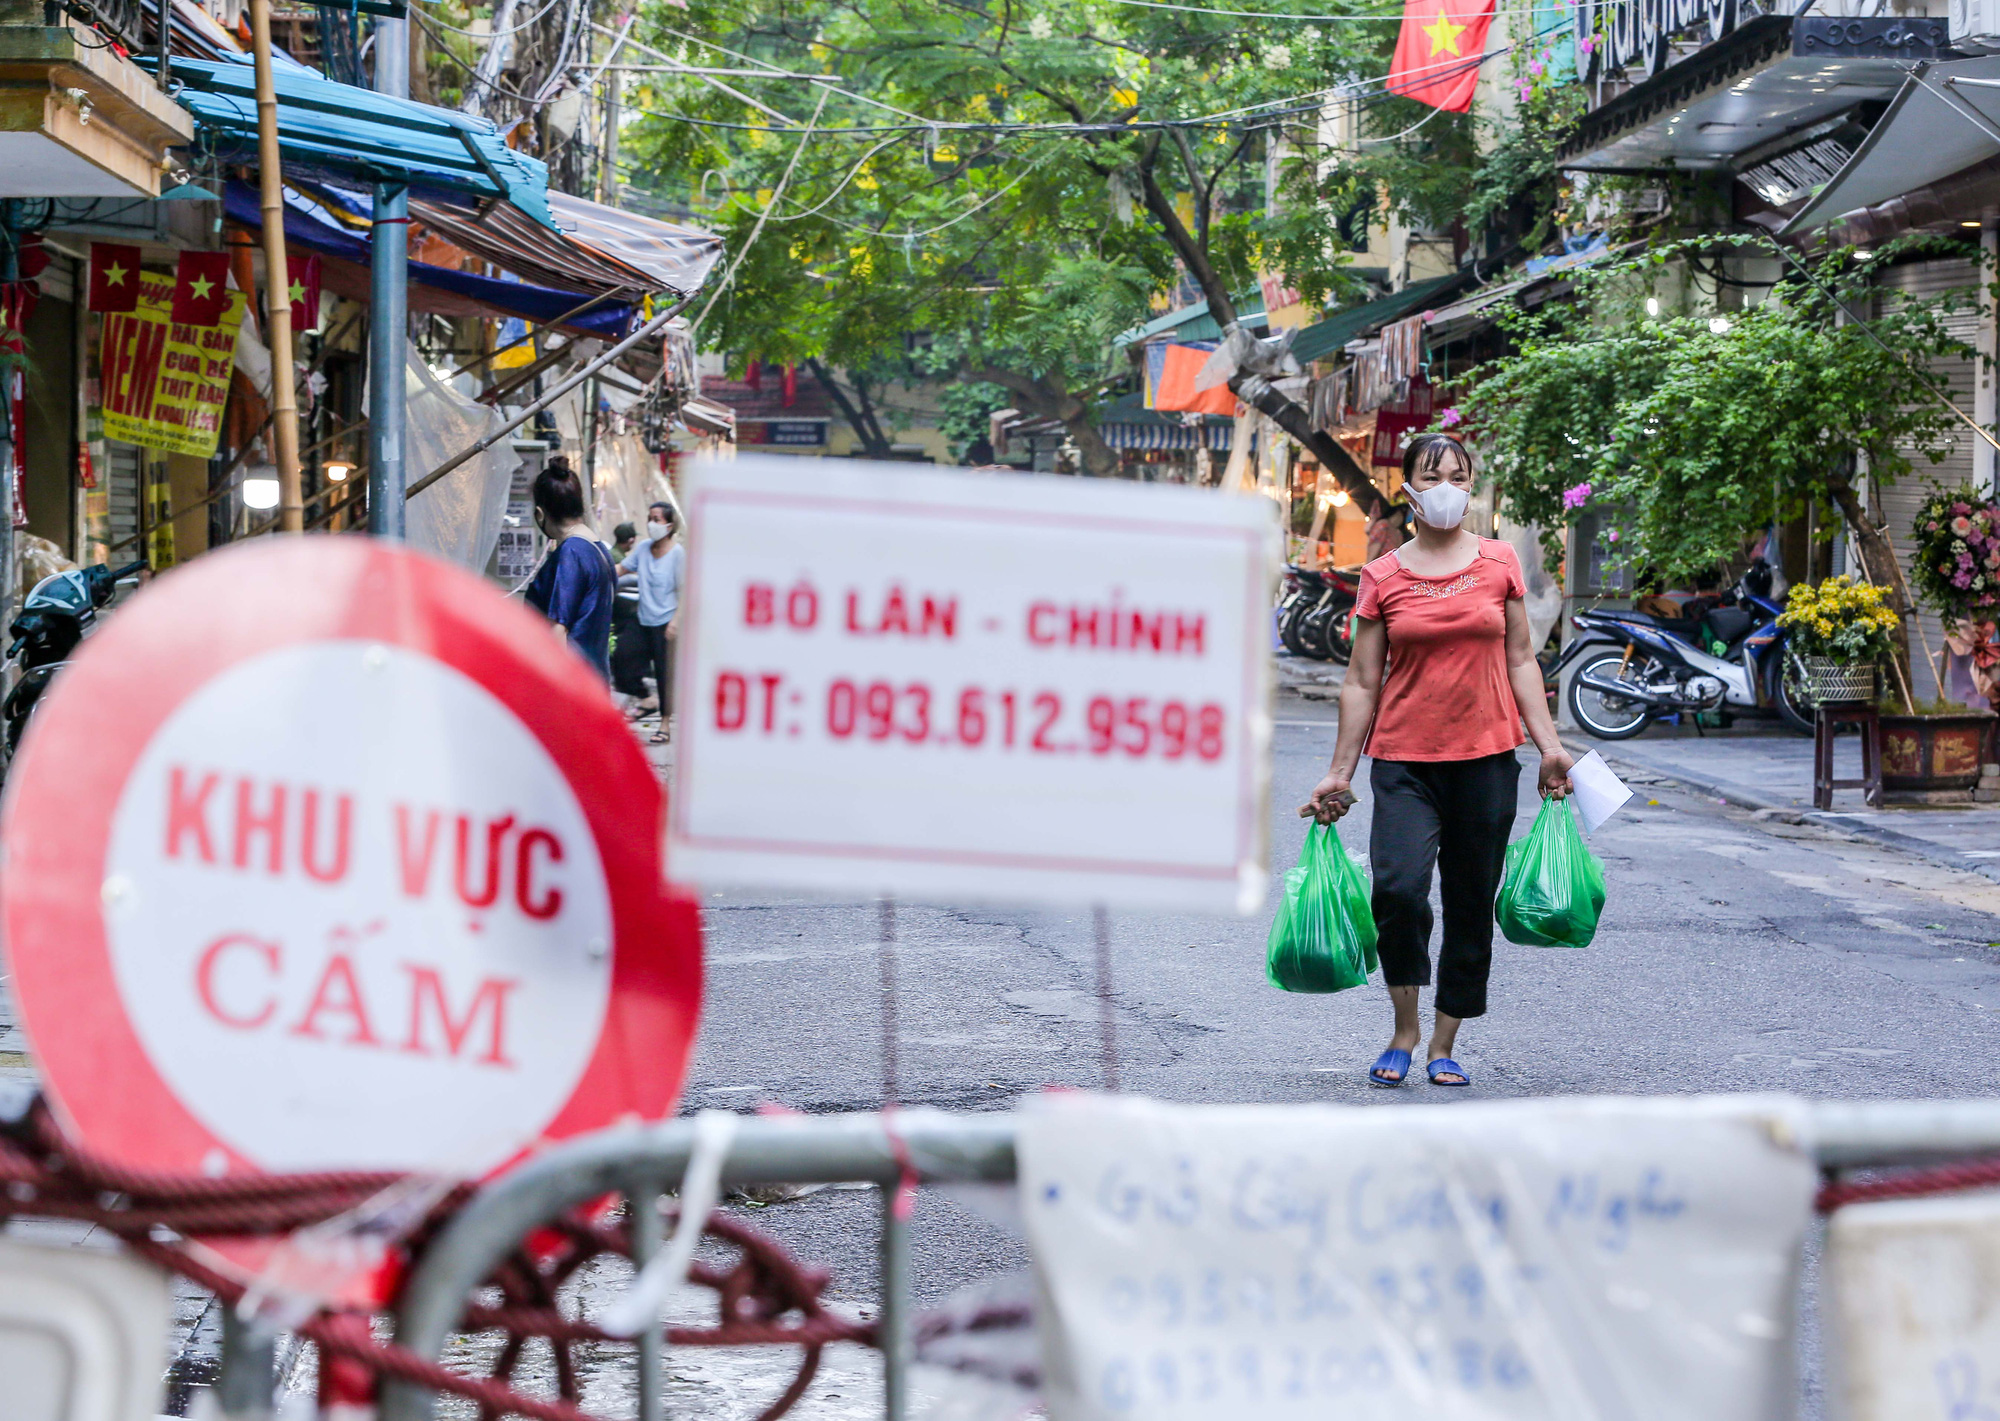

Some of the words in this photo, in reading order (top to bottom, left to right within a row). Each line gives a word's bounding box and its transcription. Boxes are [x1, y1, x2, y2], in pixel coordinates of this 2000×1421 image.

[102, 312, 168, 420] NEM
[161, 376, 194, 401] THỊT
[165, 351, 200, 375] CUA
[714, 671, 803, 737] ĐT:
[827, 678, 1226, 763] 093.612.9598
[165, 766, 353, 886] KHU
[392, 799, 566, 936] VỰC
[193, 917, 523, 1070] CẤM
